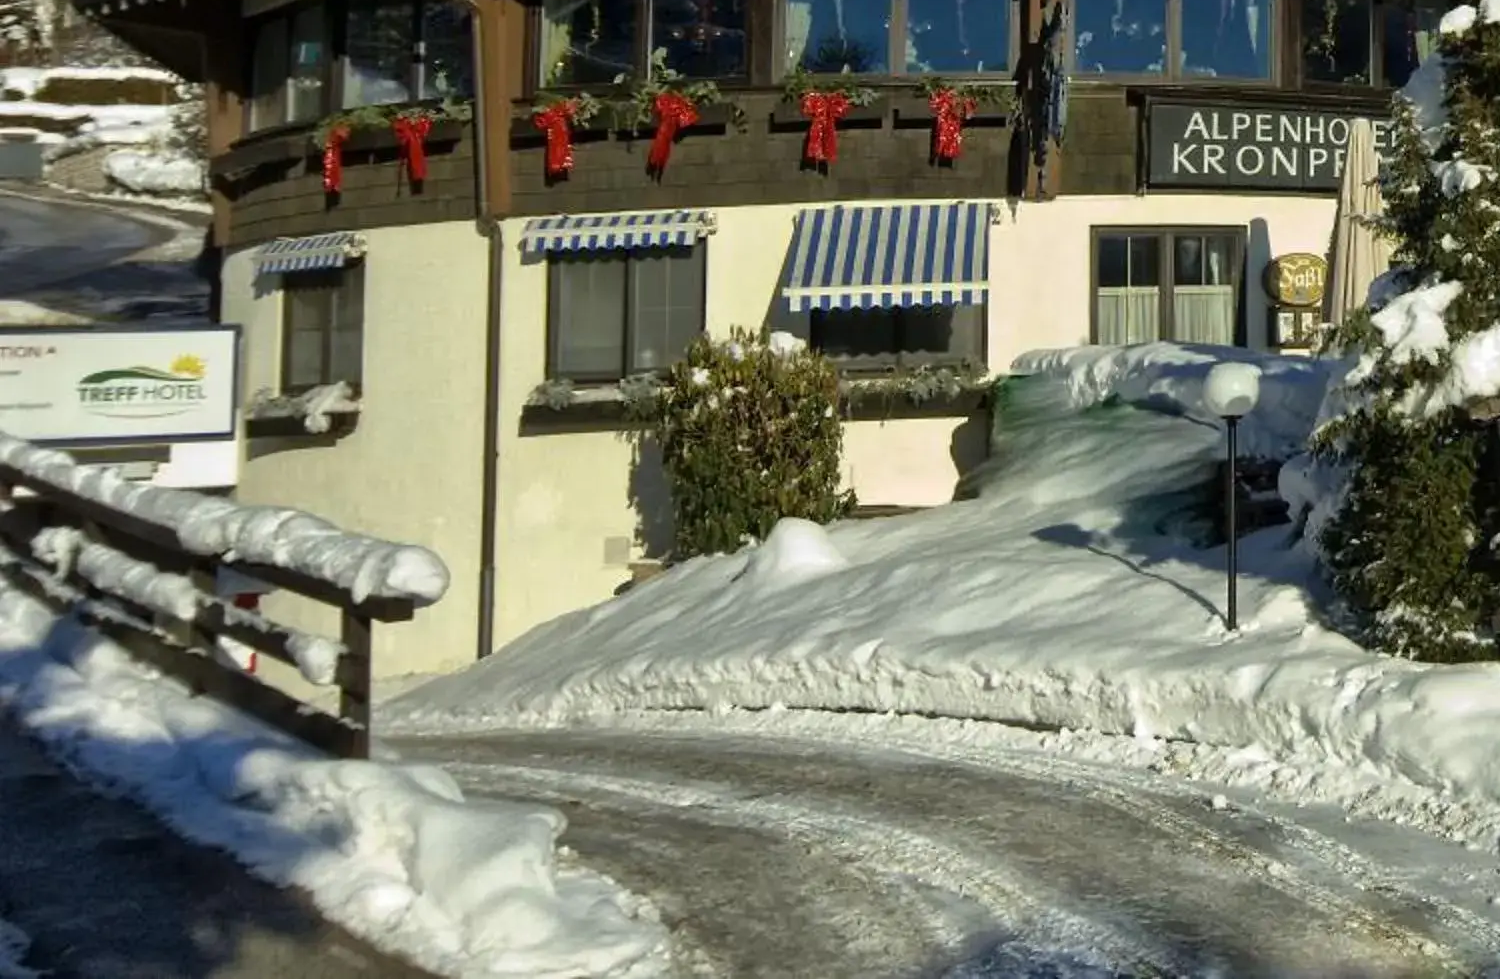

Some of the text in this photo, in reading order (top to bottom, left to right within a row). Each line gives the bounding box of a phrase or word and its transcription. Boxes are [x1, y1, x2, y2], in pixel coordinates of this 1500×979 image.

[1183, 111, 1401, 147] ALPENHOEL
[76, 383, 207, 402] TREFF HOTEL
